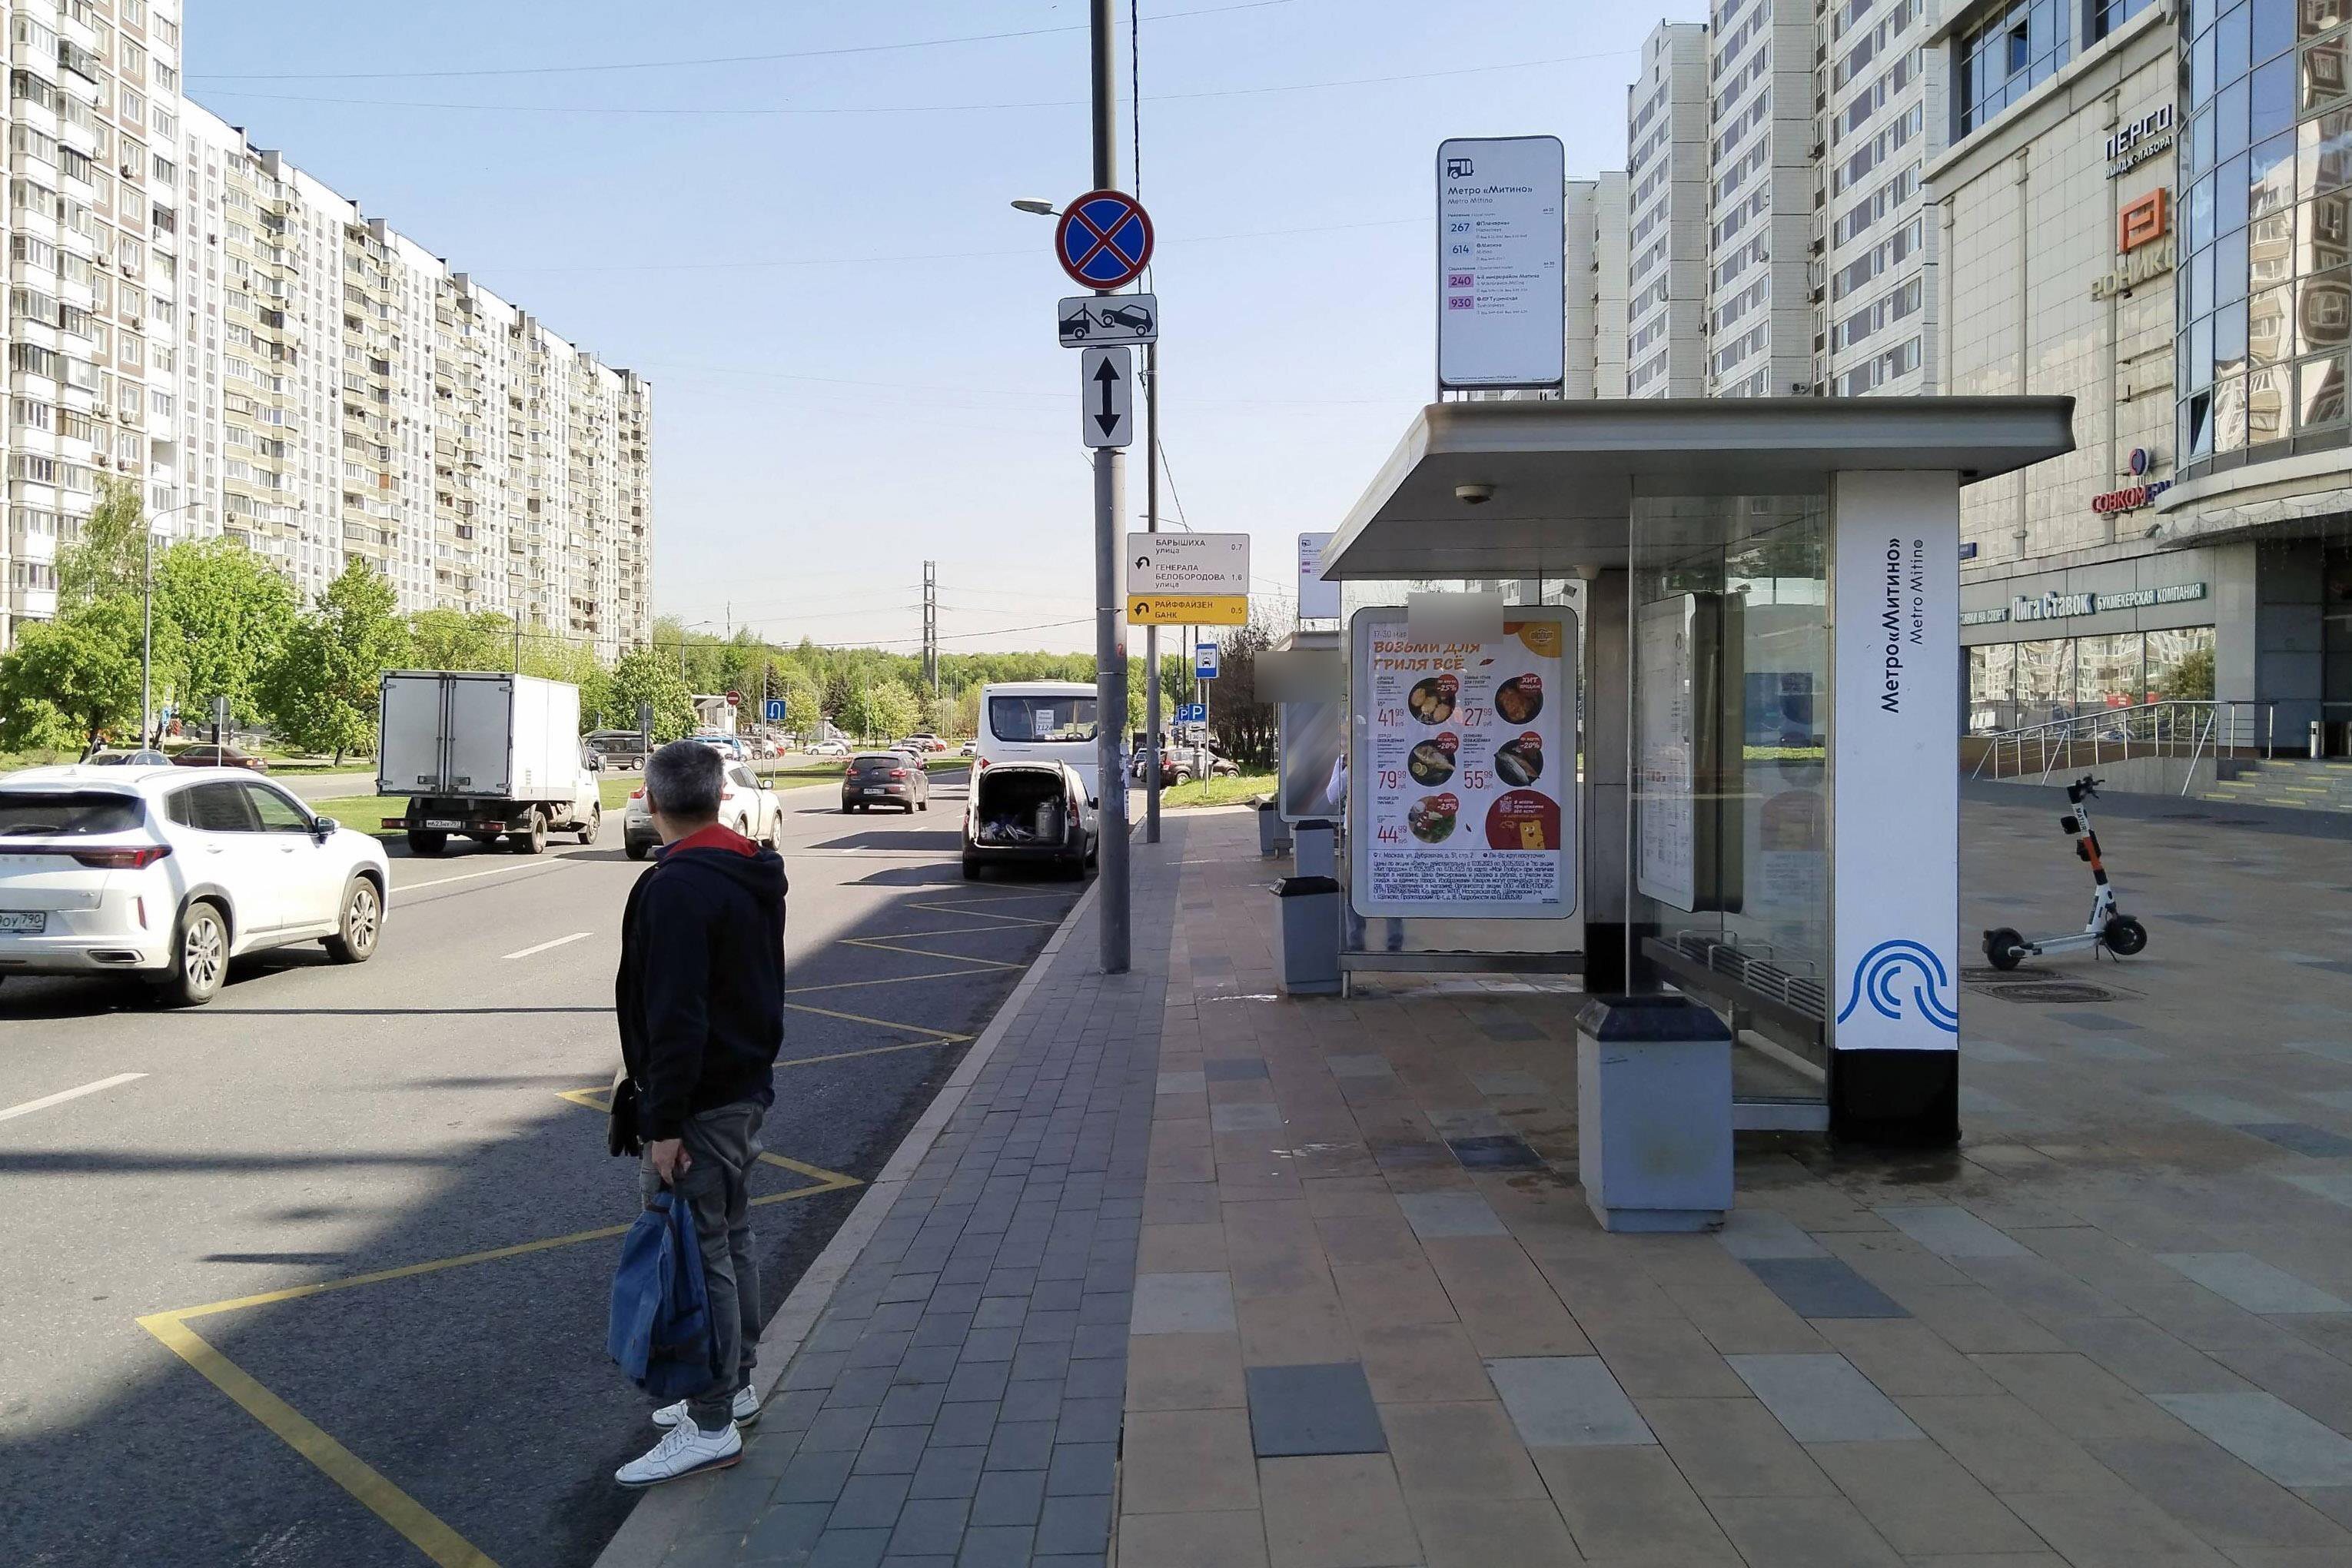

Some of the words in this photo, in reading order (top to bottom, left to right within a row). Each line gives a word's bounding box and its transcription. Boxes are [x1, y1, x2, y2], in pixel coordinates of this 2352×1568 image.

[2105, 104, 2171, 161] ПЕРСО
[1447, 187, 1480, 195] Метро
[1483, 185, 1532, 194] «Митино»
[1451, 223, 1470, 232] 267
[1452, 244, 1469, 254] 614
[1451, 276, 1471, 286] 240
[1451, 298, 1471, 307] 930
[1910, 540, 1923, 592] Mitino
[1882, 538, 1900, 641] «Митино»
[2098, 590, 2154, 610] БУКМЕКЕРСКАЯ
[2157, 583, 2201, 603] КОМПАНИЯ
[2011, 596, 2041, 621] Лига
[2043, 592, 2090, 618] Ставок
[1910, 597, 1923, 644] Metro
[1987, 609, 2007, 622] СПОРТ
[1374, 641, 1440, 653] ВОЗЬМИ
[1443, 643, 1480, 654] ДЛЯ
[1374, 658, 1429, 671] ГРИЛЯ
[1433, 655, 1465, 670] ВСЁ
[1881, 643, 1903, 713] Метро
[1180, 709, 1188, 719] P
[1192, 705, 1203, 719] P
[1377, 708, 1394, 726] 41
[1395, 708, 1404, 716] 99
[1464, 708, 1483, 726] 27
[1483, 708, 1492, 716] 99
[1377, 771, 1397, 789] 79
[1397, 770, 1407, 779] 99
[1464, 771, 1483, 789] 55
[1483, 770, 1493, 779] 99
[1377, 826, 1398, 843] 44
